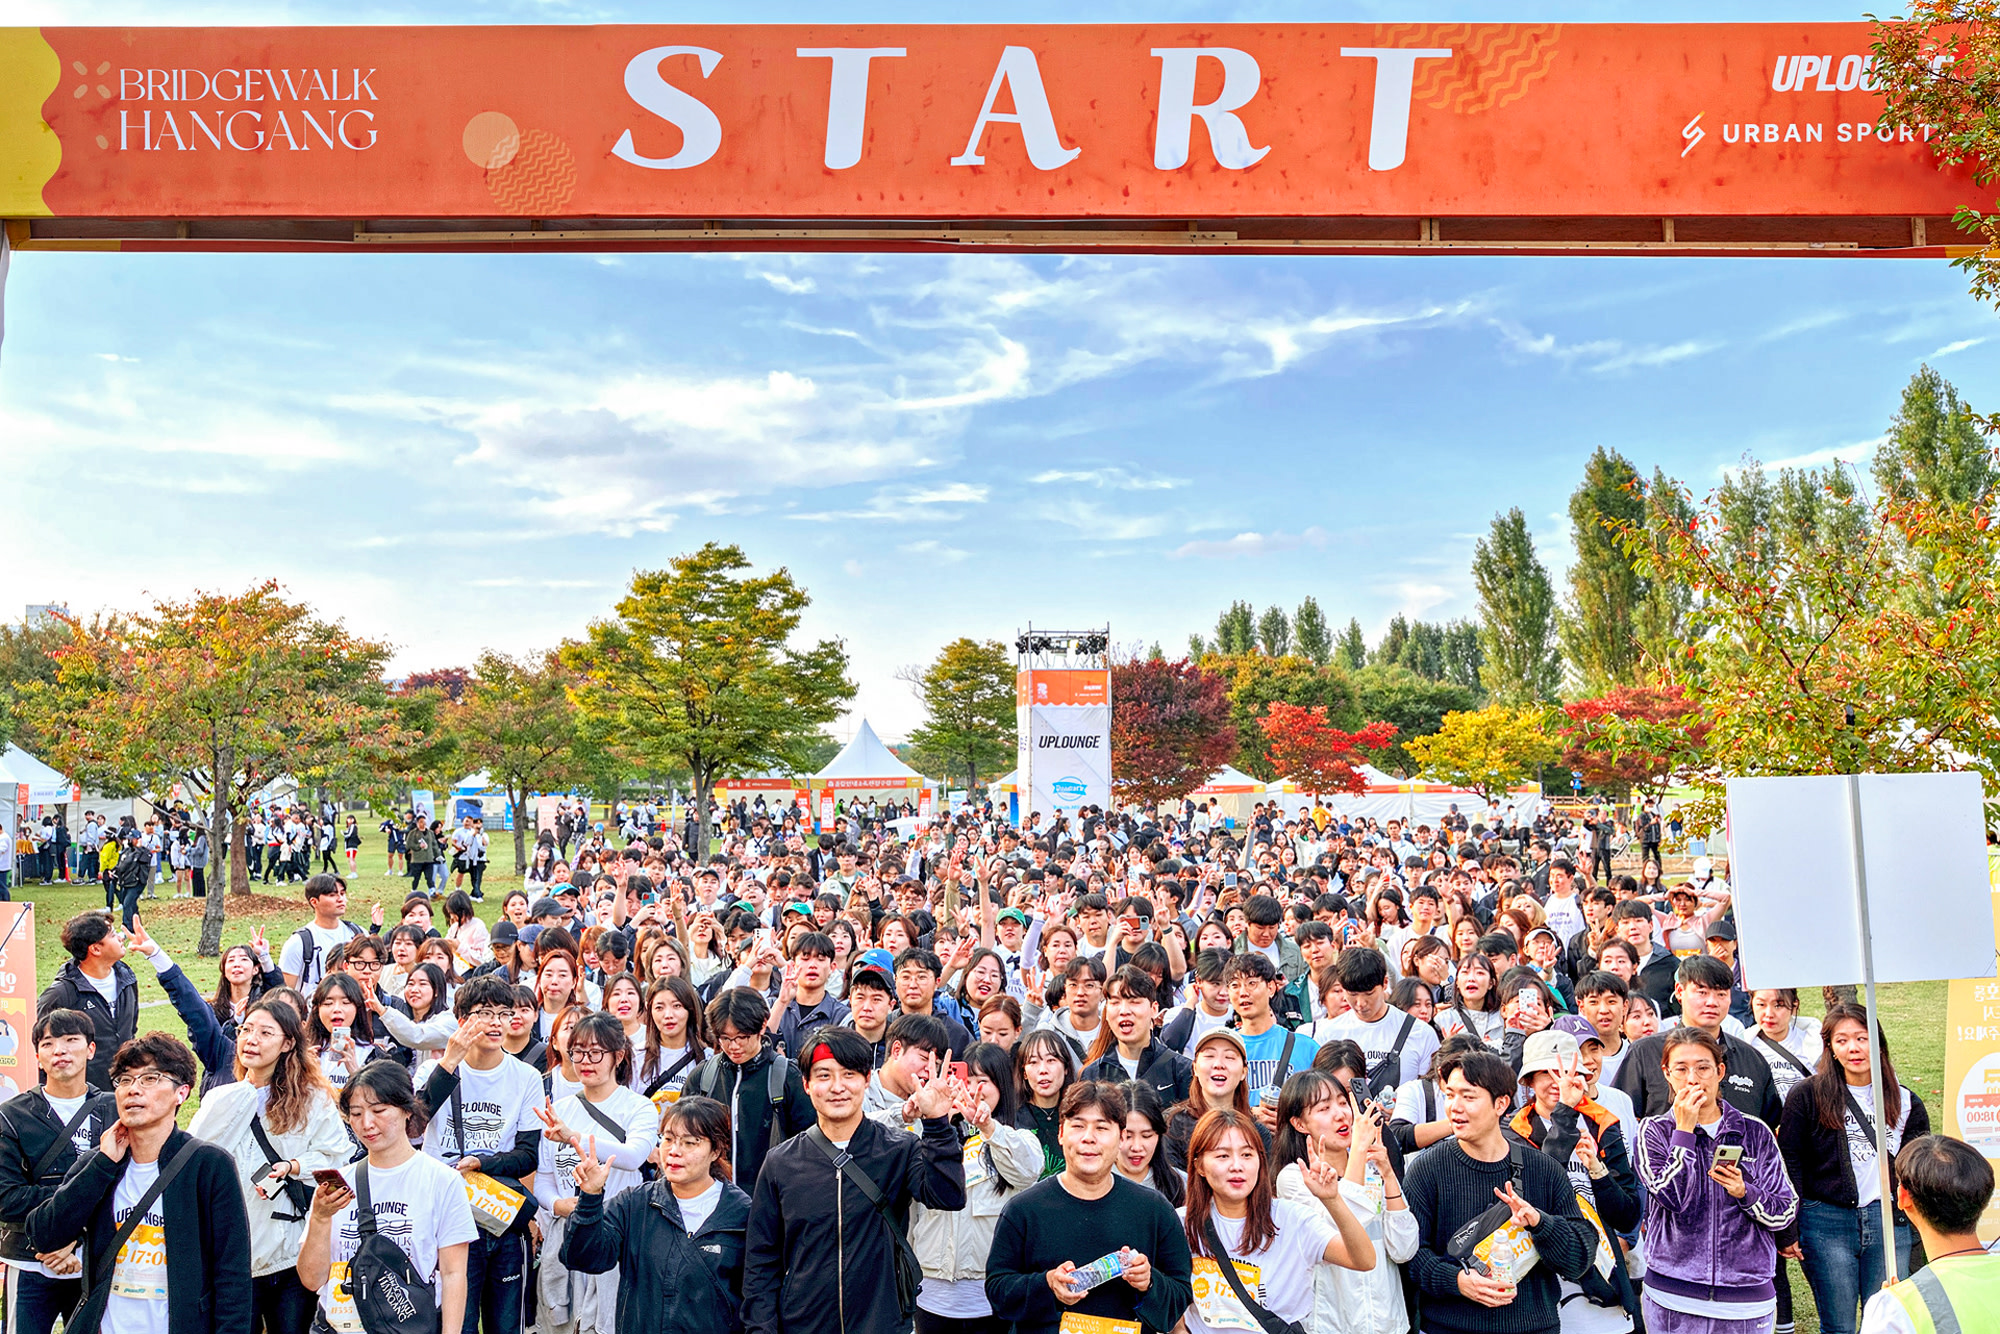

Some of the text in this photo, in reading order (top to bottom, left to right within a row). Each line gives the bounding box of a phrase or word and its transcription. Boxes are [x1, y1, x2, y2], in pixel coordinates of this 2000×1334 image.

[119, 68, 379, 102] BRIDGEWALK
[612, 46, 1452, 171] START
[119, 110, 379, 151] HANGANG
[1722, 123, 1824, 143] URBAN
[1039, 735, 1101, 749] UPLOUNGE
[475, 1196, 512, 1223] 17:00
[130, 1249, 168, 1267] 17:0
